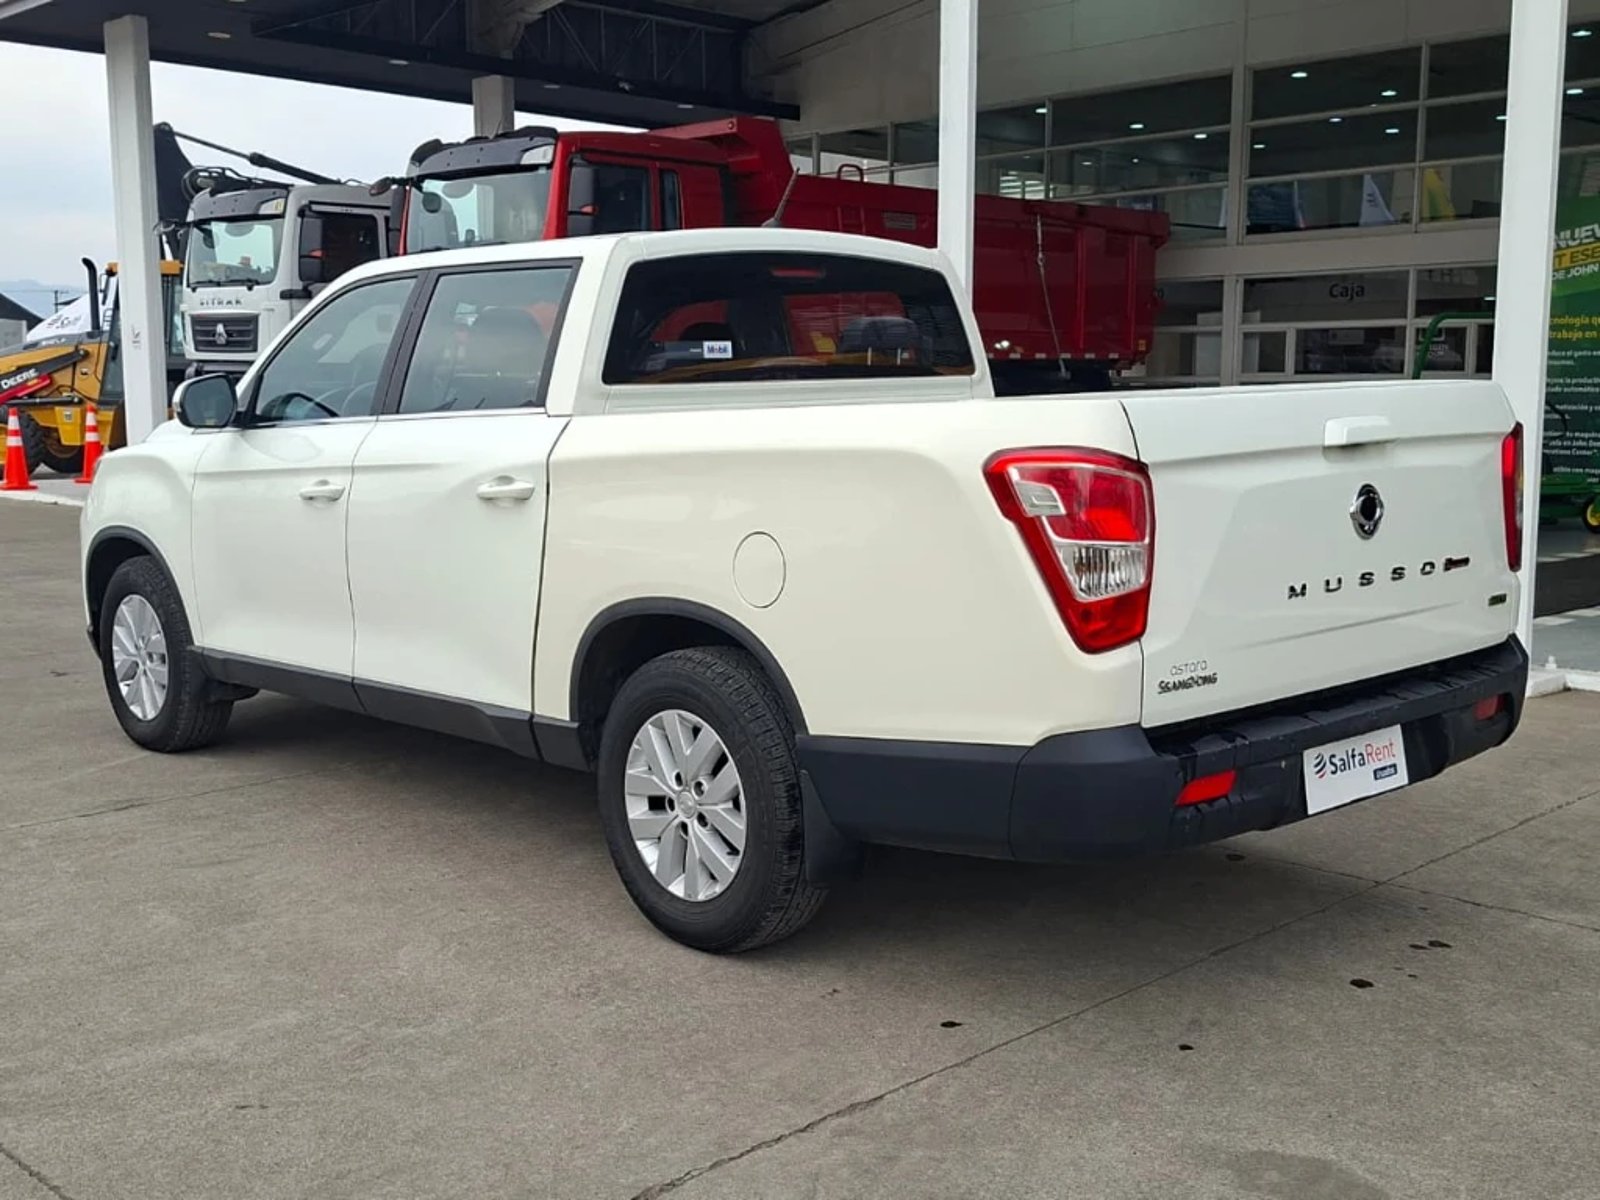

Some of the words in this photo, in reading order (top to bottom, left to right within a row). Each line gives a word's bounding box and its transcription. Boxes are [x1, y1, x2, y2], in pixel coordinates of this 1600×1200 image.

[1567, 263, 1599, 278] JOHN
[1329, 282, 1365, 301] Caja
[1, 368, 39, 389] DEERE
[1288, 561, 1435, 600] MUSSO
[1170, 660, 1207, 676] astara
[1328, 739, 1396, 775] SalfaRent
